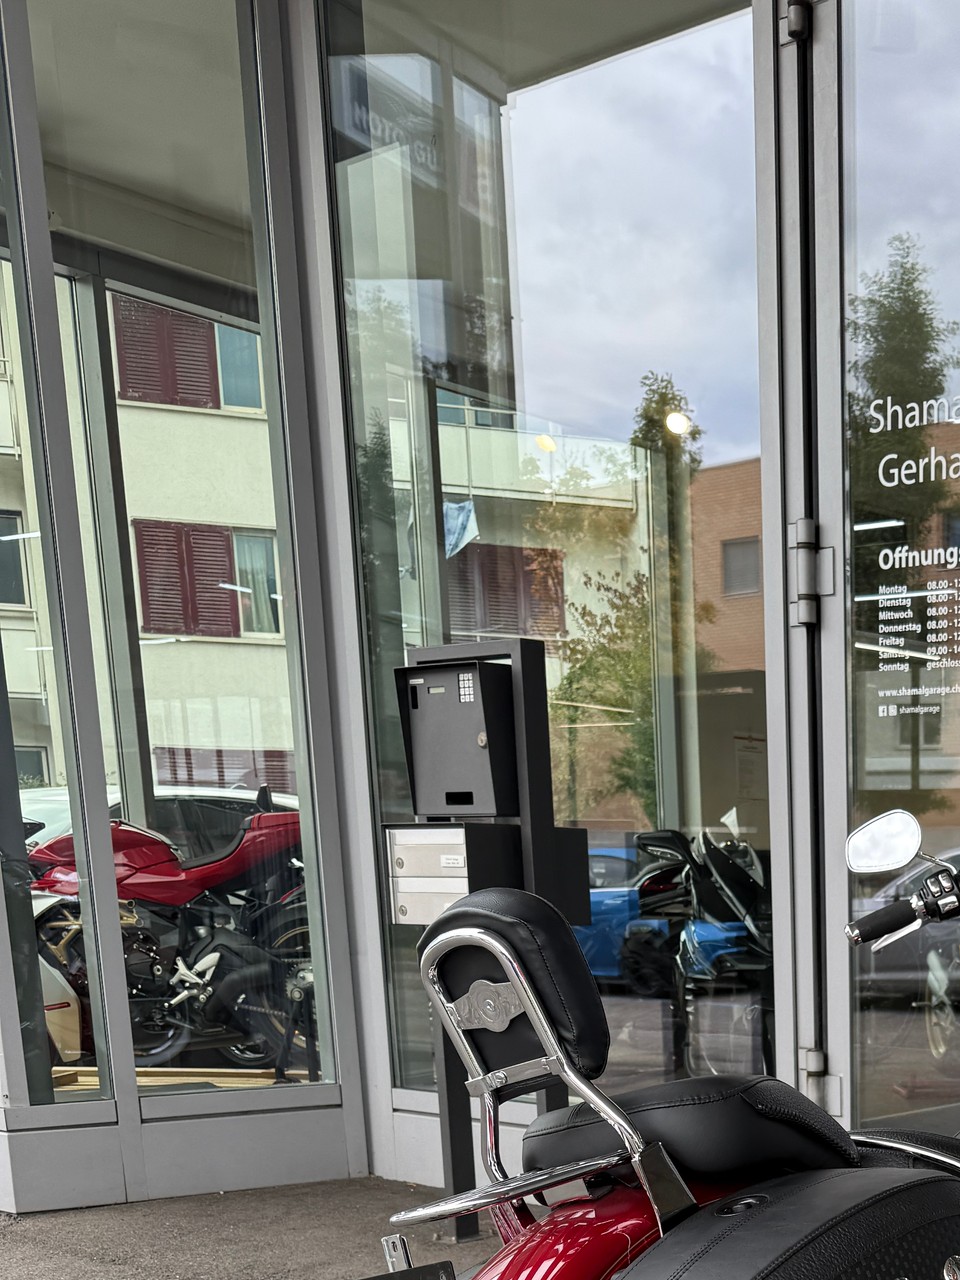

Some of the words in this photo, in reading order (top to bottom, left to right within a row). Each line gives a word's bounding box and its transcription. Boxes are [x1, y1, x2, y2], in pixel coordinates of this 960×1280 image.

[879, 585, 907, 595] Montag
[927, 580, 948, 590] 08.00
[879, 598, 911, 607] Dienstag
[927, 593, 948, 603] 08.00
[879, 609, 913, 620] Mittwoch
[927, 606, 948, 616] 08.00
[879, 623, 921, 633] Donnerstag
[926, 620, 948, 629] 08.00
[879, 636, 904, 647] Freitag
[926, 633, 948, 643] 08.00
[926, 646, 948, 656] 09.00
[879, 662, 909, 672] Sonntag
[878, 684, 960, 697] www.shamalgarage.ch
[900, 705, 941, 715] shamalgarage
